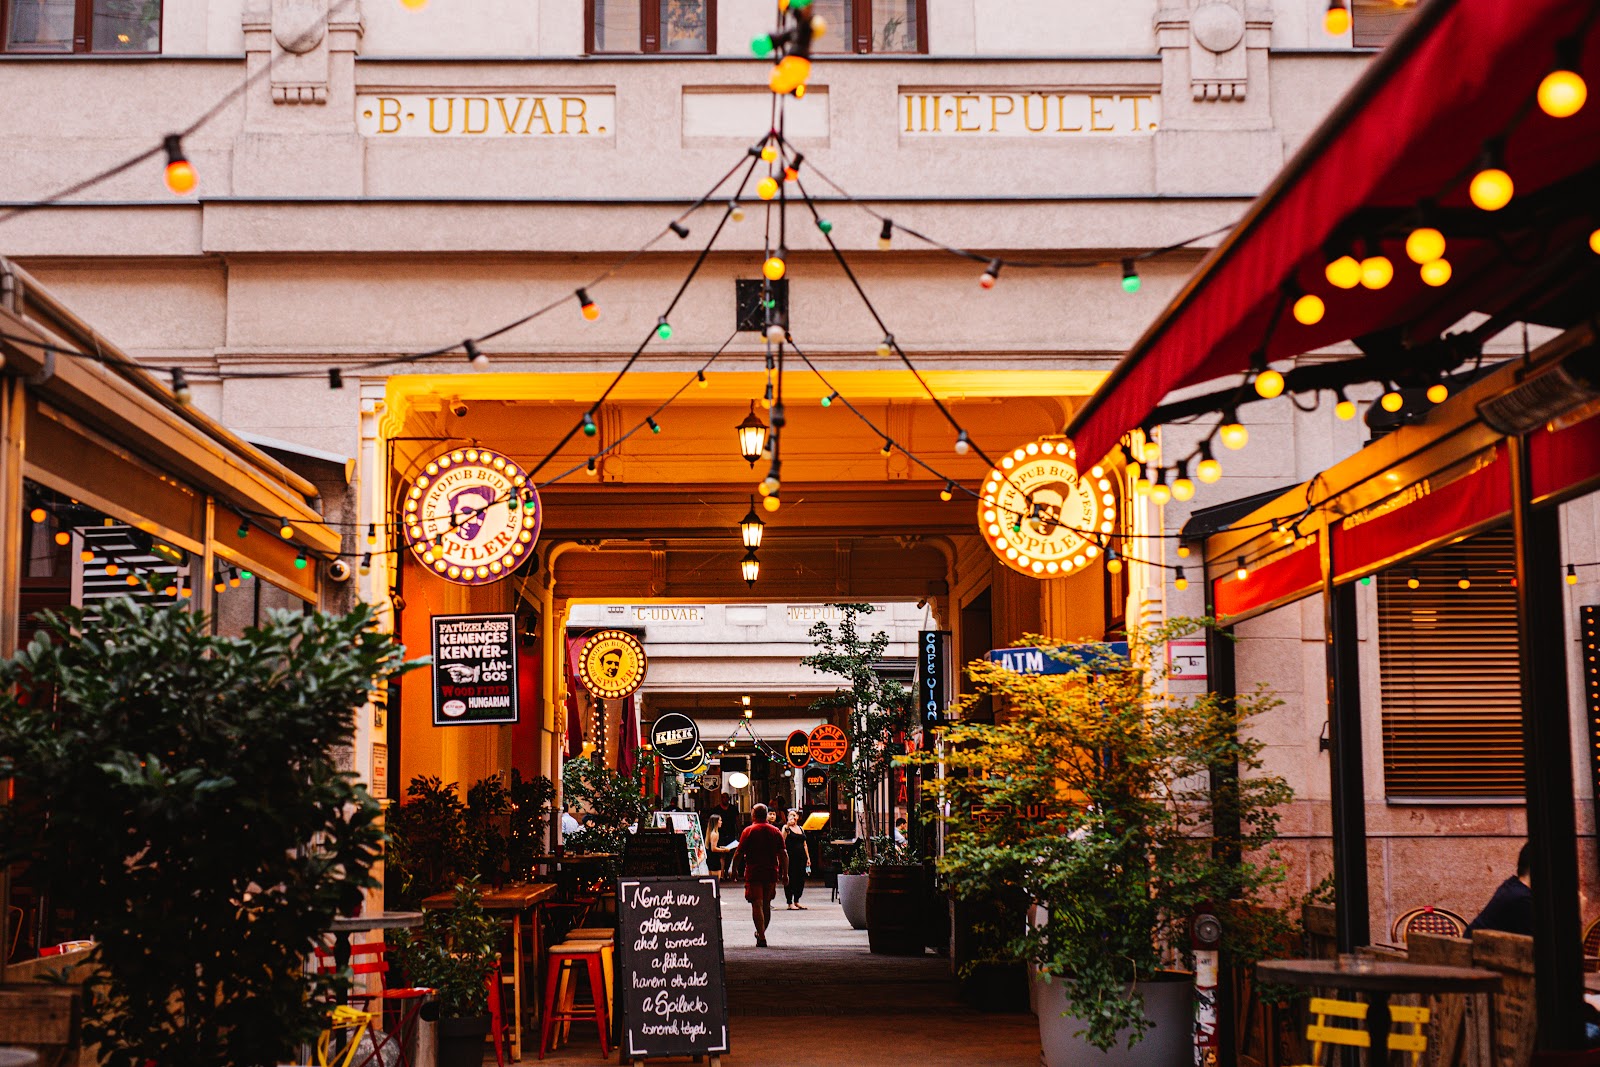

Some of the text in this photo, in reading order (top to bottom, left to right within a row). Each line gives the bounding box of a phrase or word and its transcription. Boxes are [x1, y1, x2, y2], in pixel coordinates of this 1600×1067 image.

[1050, 466, 1092, 525] BUDPEST
[433, 531, 512, 560] PÍLER
[1011, 528, 1082, 555] SPÍLE
[440, 643, 508, 659] KENYÉR-
[482, 659, 512, 671] LÁN-
[1001, 651, 1044, 673] ATM
[482, 671, 508, 681] GOS
[468, 696, 510, 708] HUNGARIAN
[814, 727, 841, 739] JAMIE
[813, 749, 843, 762] OLIVER
[631, 886, 660, 909] Nem
[677, 894, 700, 906] van
[654, 906, 671, 919] az
[634, 933, 707, 951] ahol ismered
[652, 958, 662, 968] a
[633, 971, 666, 988] hanem
